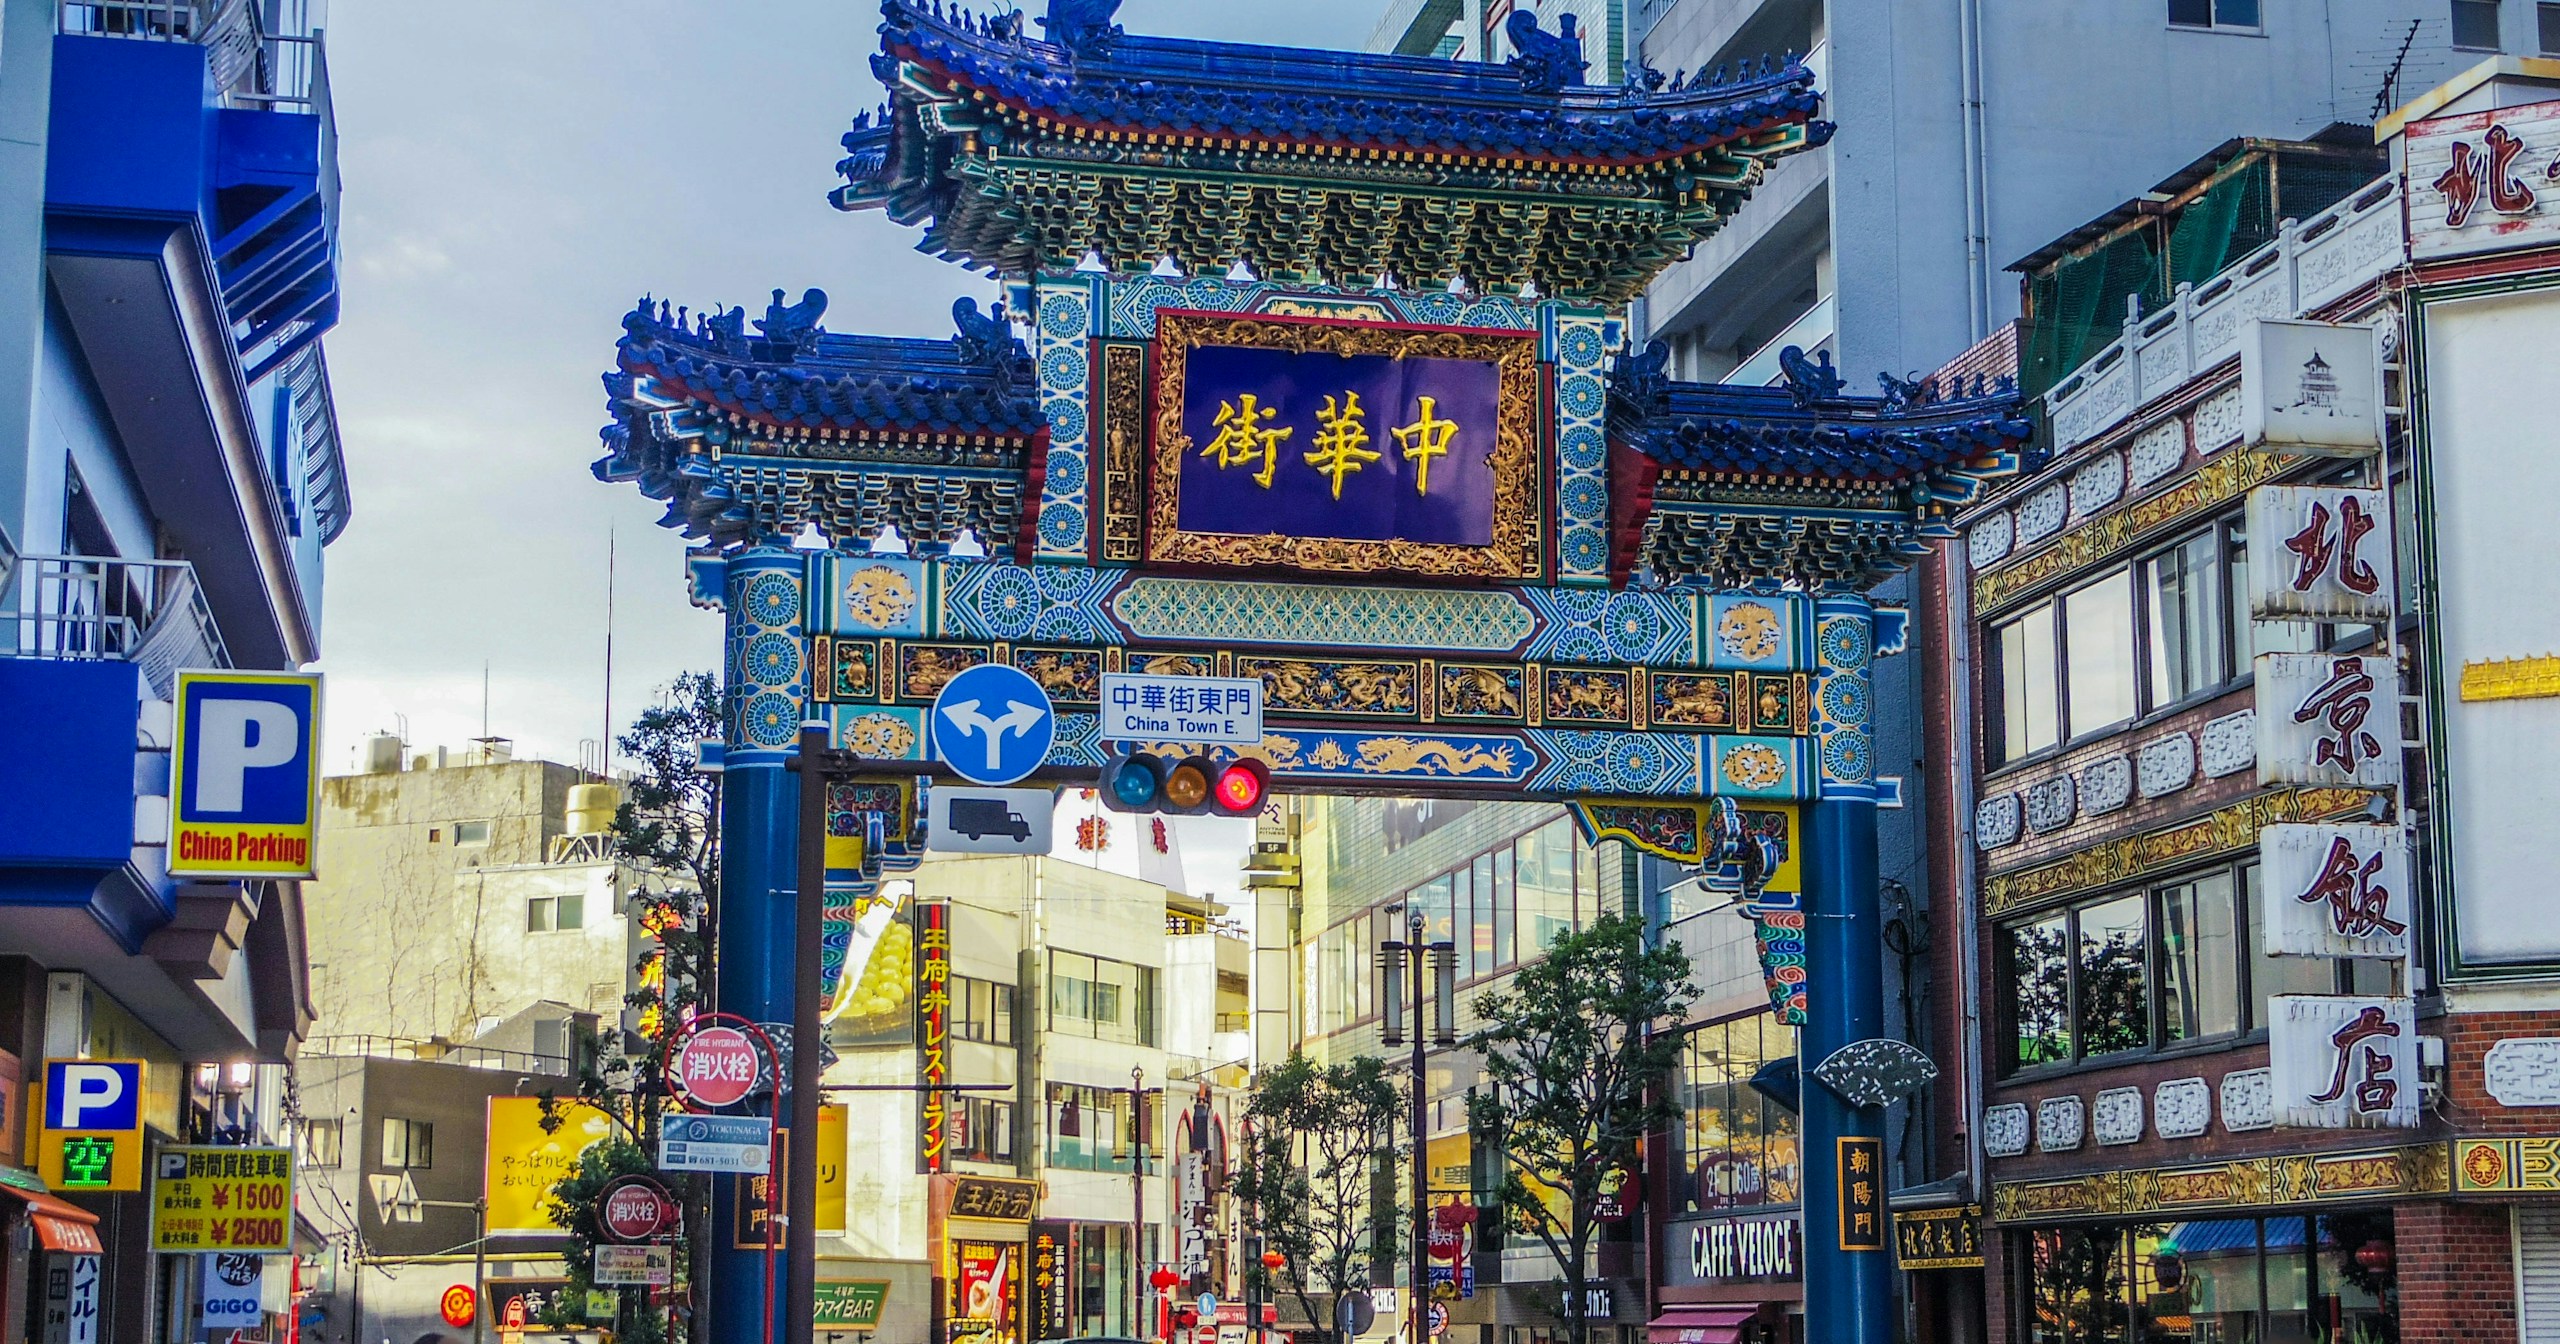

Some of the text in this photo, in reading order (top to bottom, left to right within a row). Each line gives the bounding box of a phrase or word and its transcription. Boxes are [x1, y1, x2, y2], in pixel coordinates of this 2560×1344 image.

[2431, 124, 2560, 230] 北
[1113, 683, 1250, 716] 中華街東門
[1125, 715, 1239, 735] China Town E.
[196, 698, 299, 812] P
[180, 830, 307, 866] China Parking
[1267, 844, 1279, 853] 5F
[695, 1039, 745, 1048] FIRE HYDRANT
[920, 928, 950, 1159] 王府井レストラン
[688, 1052, 751, 1082] 消火栓
[62, 1065, 123, 1128] P
[710, 1124, 762, 1136] TOKUNAGA
[64, 1136, 114, 1187] 空
[161, 1154, 288, 1179] P 時間貸駐車場
[502, 1155, 568, 1169] やっぱりビ
[699, 1156, 739, 1166] 681-5031
[174, 1184, 192, 1195] 平日
[960, 1185, 1030, 1218] 王府井
[1849, 1147, 1873, 1235] 朝陽門
[164, 1197, 202, 1209] 最大料金
[612, 1201, 656, 1222] 消火栓
[162, 1232, 199, 1244] 最大料金
[1736, 1219, 1794, 1276] VELOCE
[1036, 1233, 1055, 1339] 王府井レストラン
[206, 1299, 258, 1314] GiGO
[814, 1298, 875, 1319] ウマイBAR
